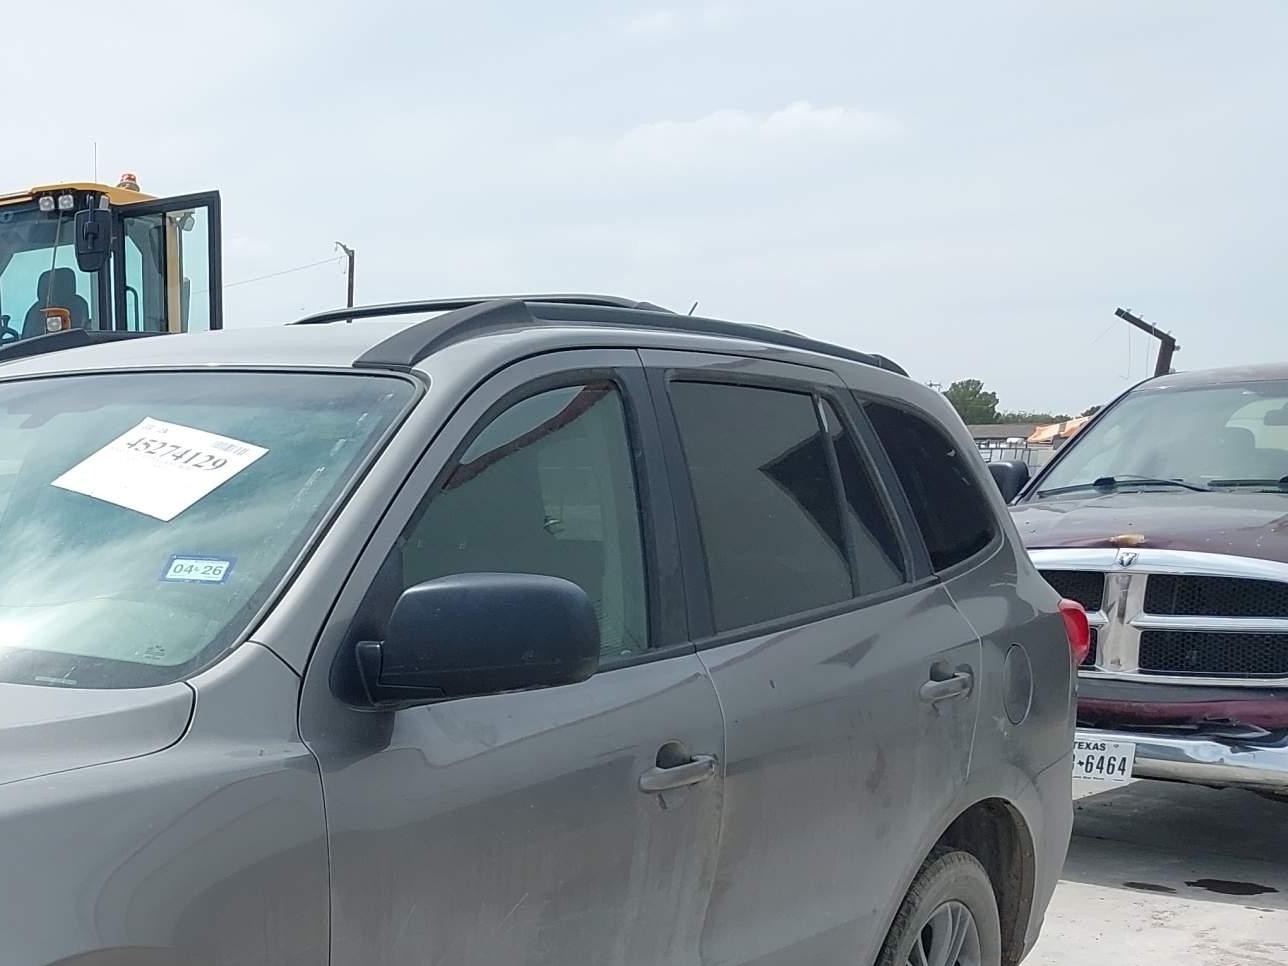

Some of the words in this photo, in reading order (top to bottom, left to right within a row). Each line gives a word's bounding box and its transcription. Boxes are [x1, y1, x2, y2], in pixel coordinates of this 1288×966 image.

[126, 436, 228, 471] 45274129
[173, 564, 194, 574] 04
[200, 565, 224, 576] 26
[1073, 741, 1106, 751] TEXAS
